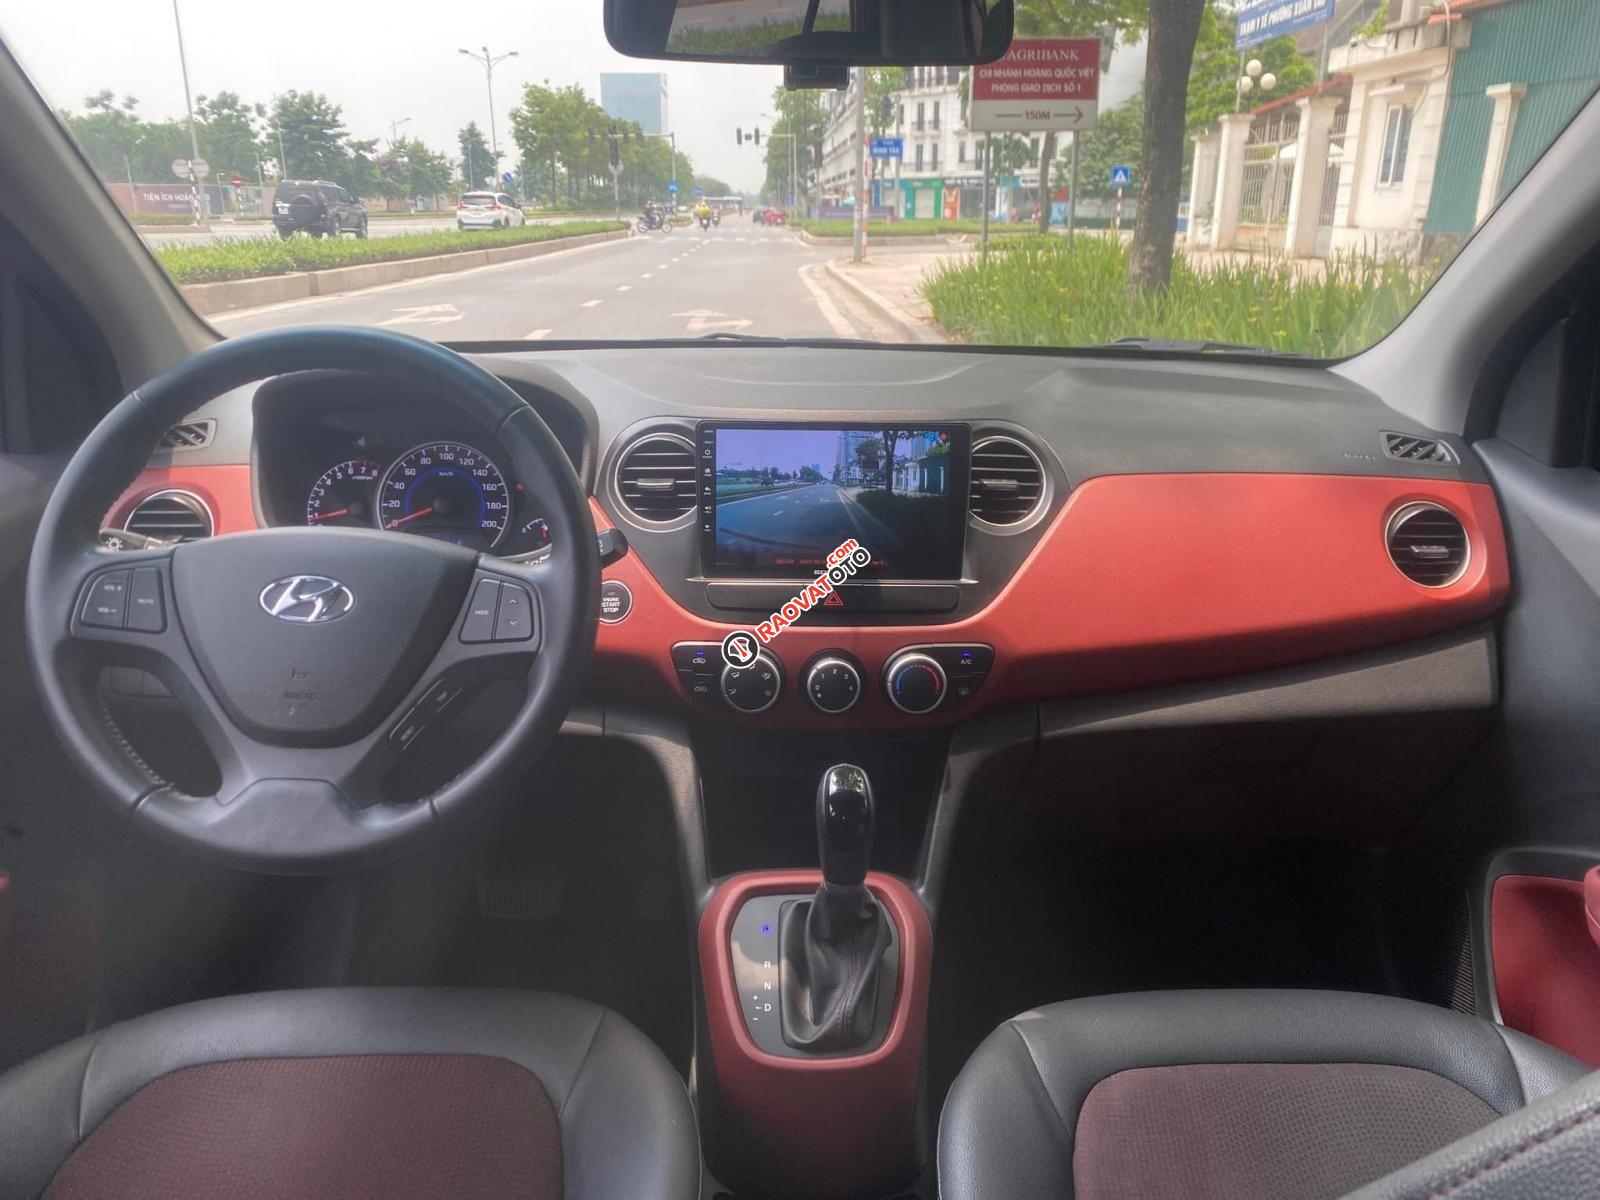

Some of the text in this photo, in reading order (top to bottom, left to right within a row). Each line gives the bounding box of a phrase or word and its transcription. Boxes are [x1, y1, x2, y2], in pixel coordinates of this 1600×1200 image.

[1006, 48, 1079, 61] AGRIBANK
[979, 68, 993, 78] CHI
[1021, 83, 1041, 93] GIAO
[1025, 109, 1051, 120] 150M
[439, 452, 454, 460] 100
[347, 467, 354, 475] 6
[360, 466, 366, 474] 7
[404, 468, 416, 476] 60
[472, 468, 488, 476] 140
[336, 472, 343, 480] 5
[325, 478, 332, 486] 4
[393, 481, 405, 490] 40
[482, 483, 497, 491] 160
[481, 520, 497, 528] 200
[764, 961, 772, 969] R
[764, 982, 772, 990] N
[764, 1003, 772, 1012] D
